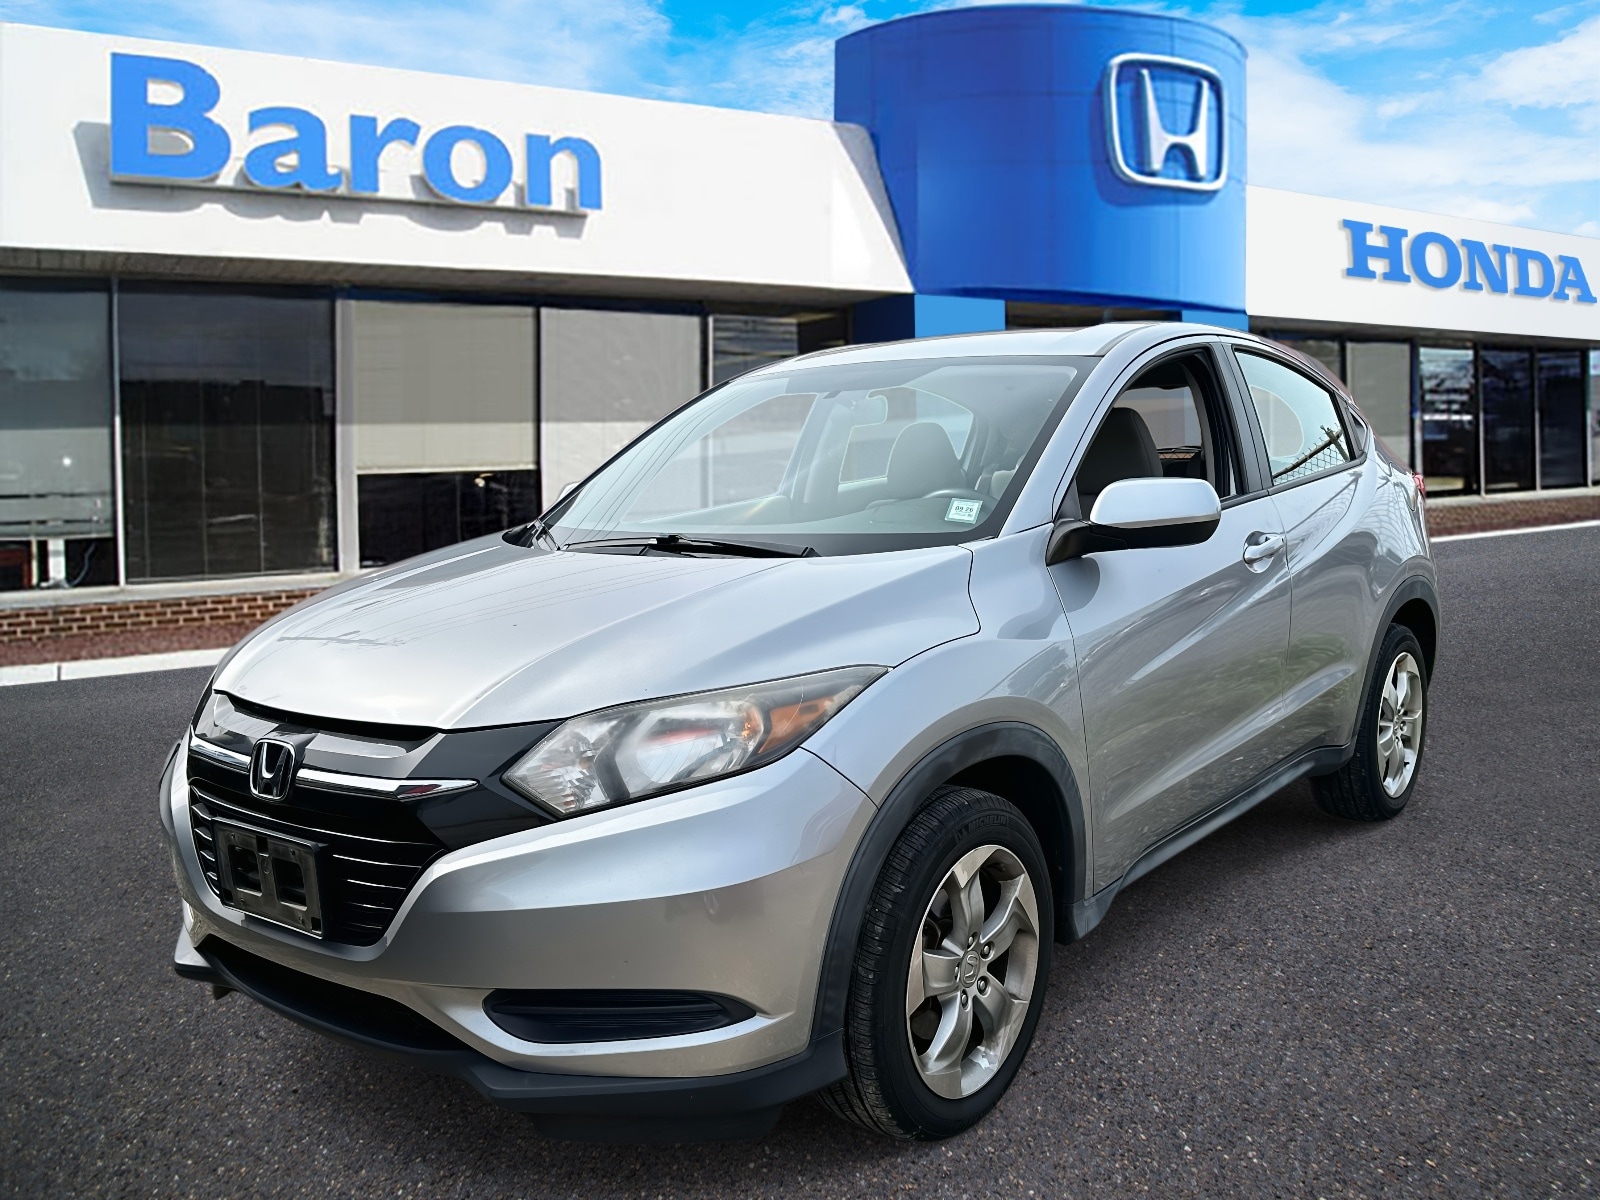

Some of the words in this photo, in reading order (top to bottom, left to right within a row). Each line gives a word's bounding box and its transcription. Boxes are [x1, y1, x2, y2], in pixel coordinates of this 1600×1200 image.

[111, 52, 603, 210] Baron
[1342, 218, 1597, 303] HONDA
[968, 814, 1008, 833] MICHELIN
